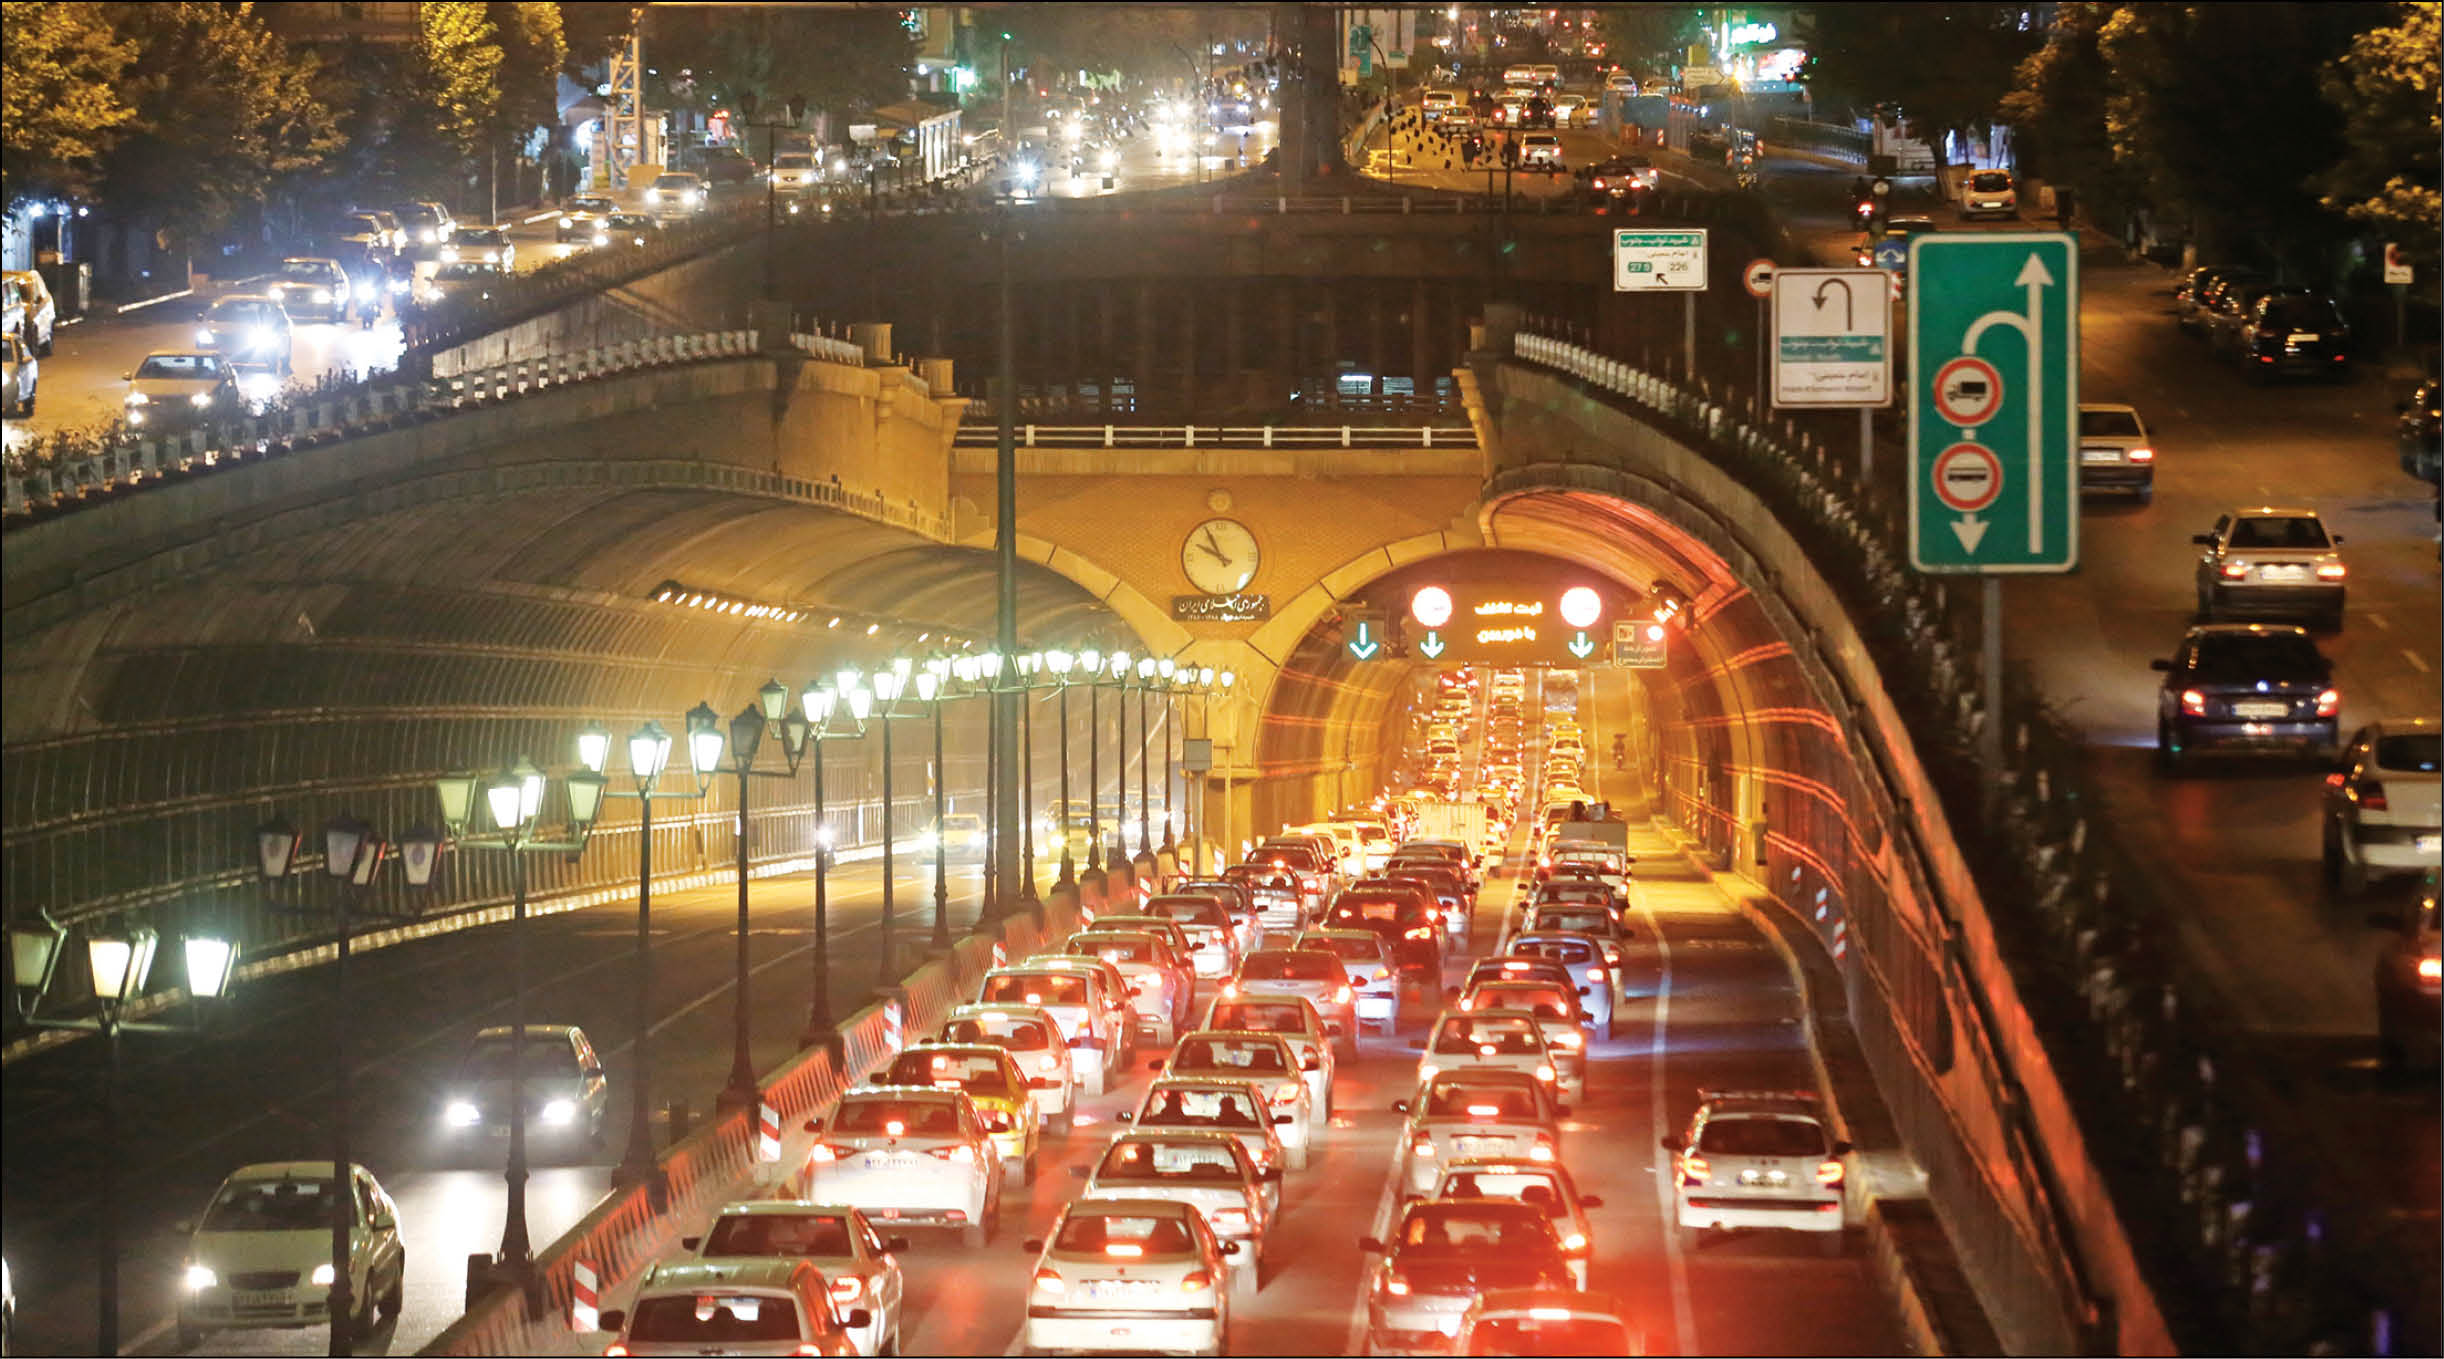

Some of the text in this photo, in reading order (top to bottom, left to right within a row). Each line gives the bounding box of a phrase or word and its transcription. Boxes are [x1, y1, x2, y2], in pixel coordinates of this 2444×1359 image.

[1669, 261, 1688, 272] 226
[1179, 601, 1200, 613] ایران
[1237, 593, 1264, 613] جمهوری
